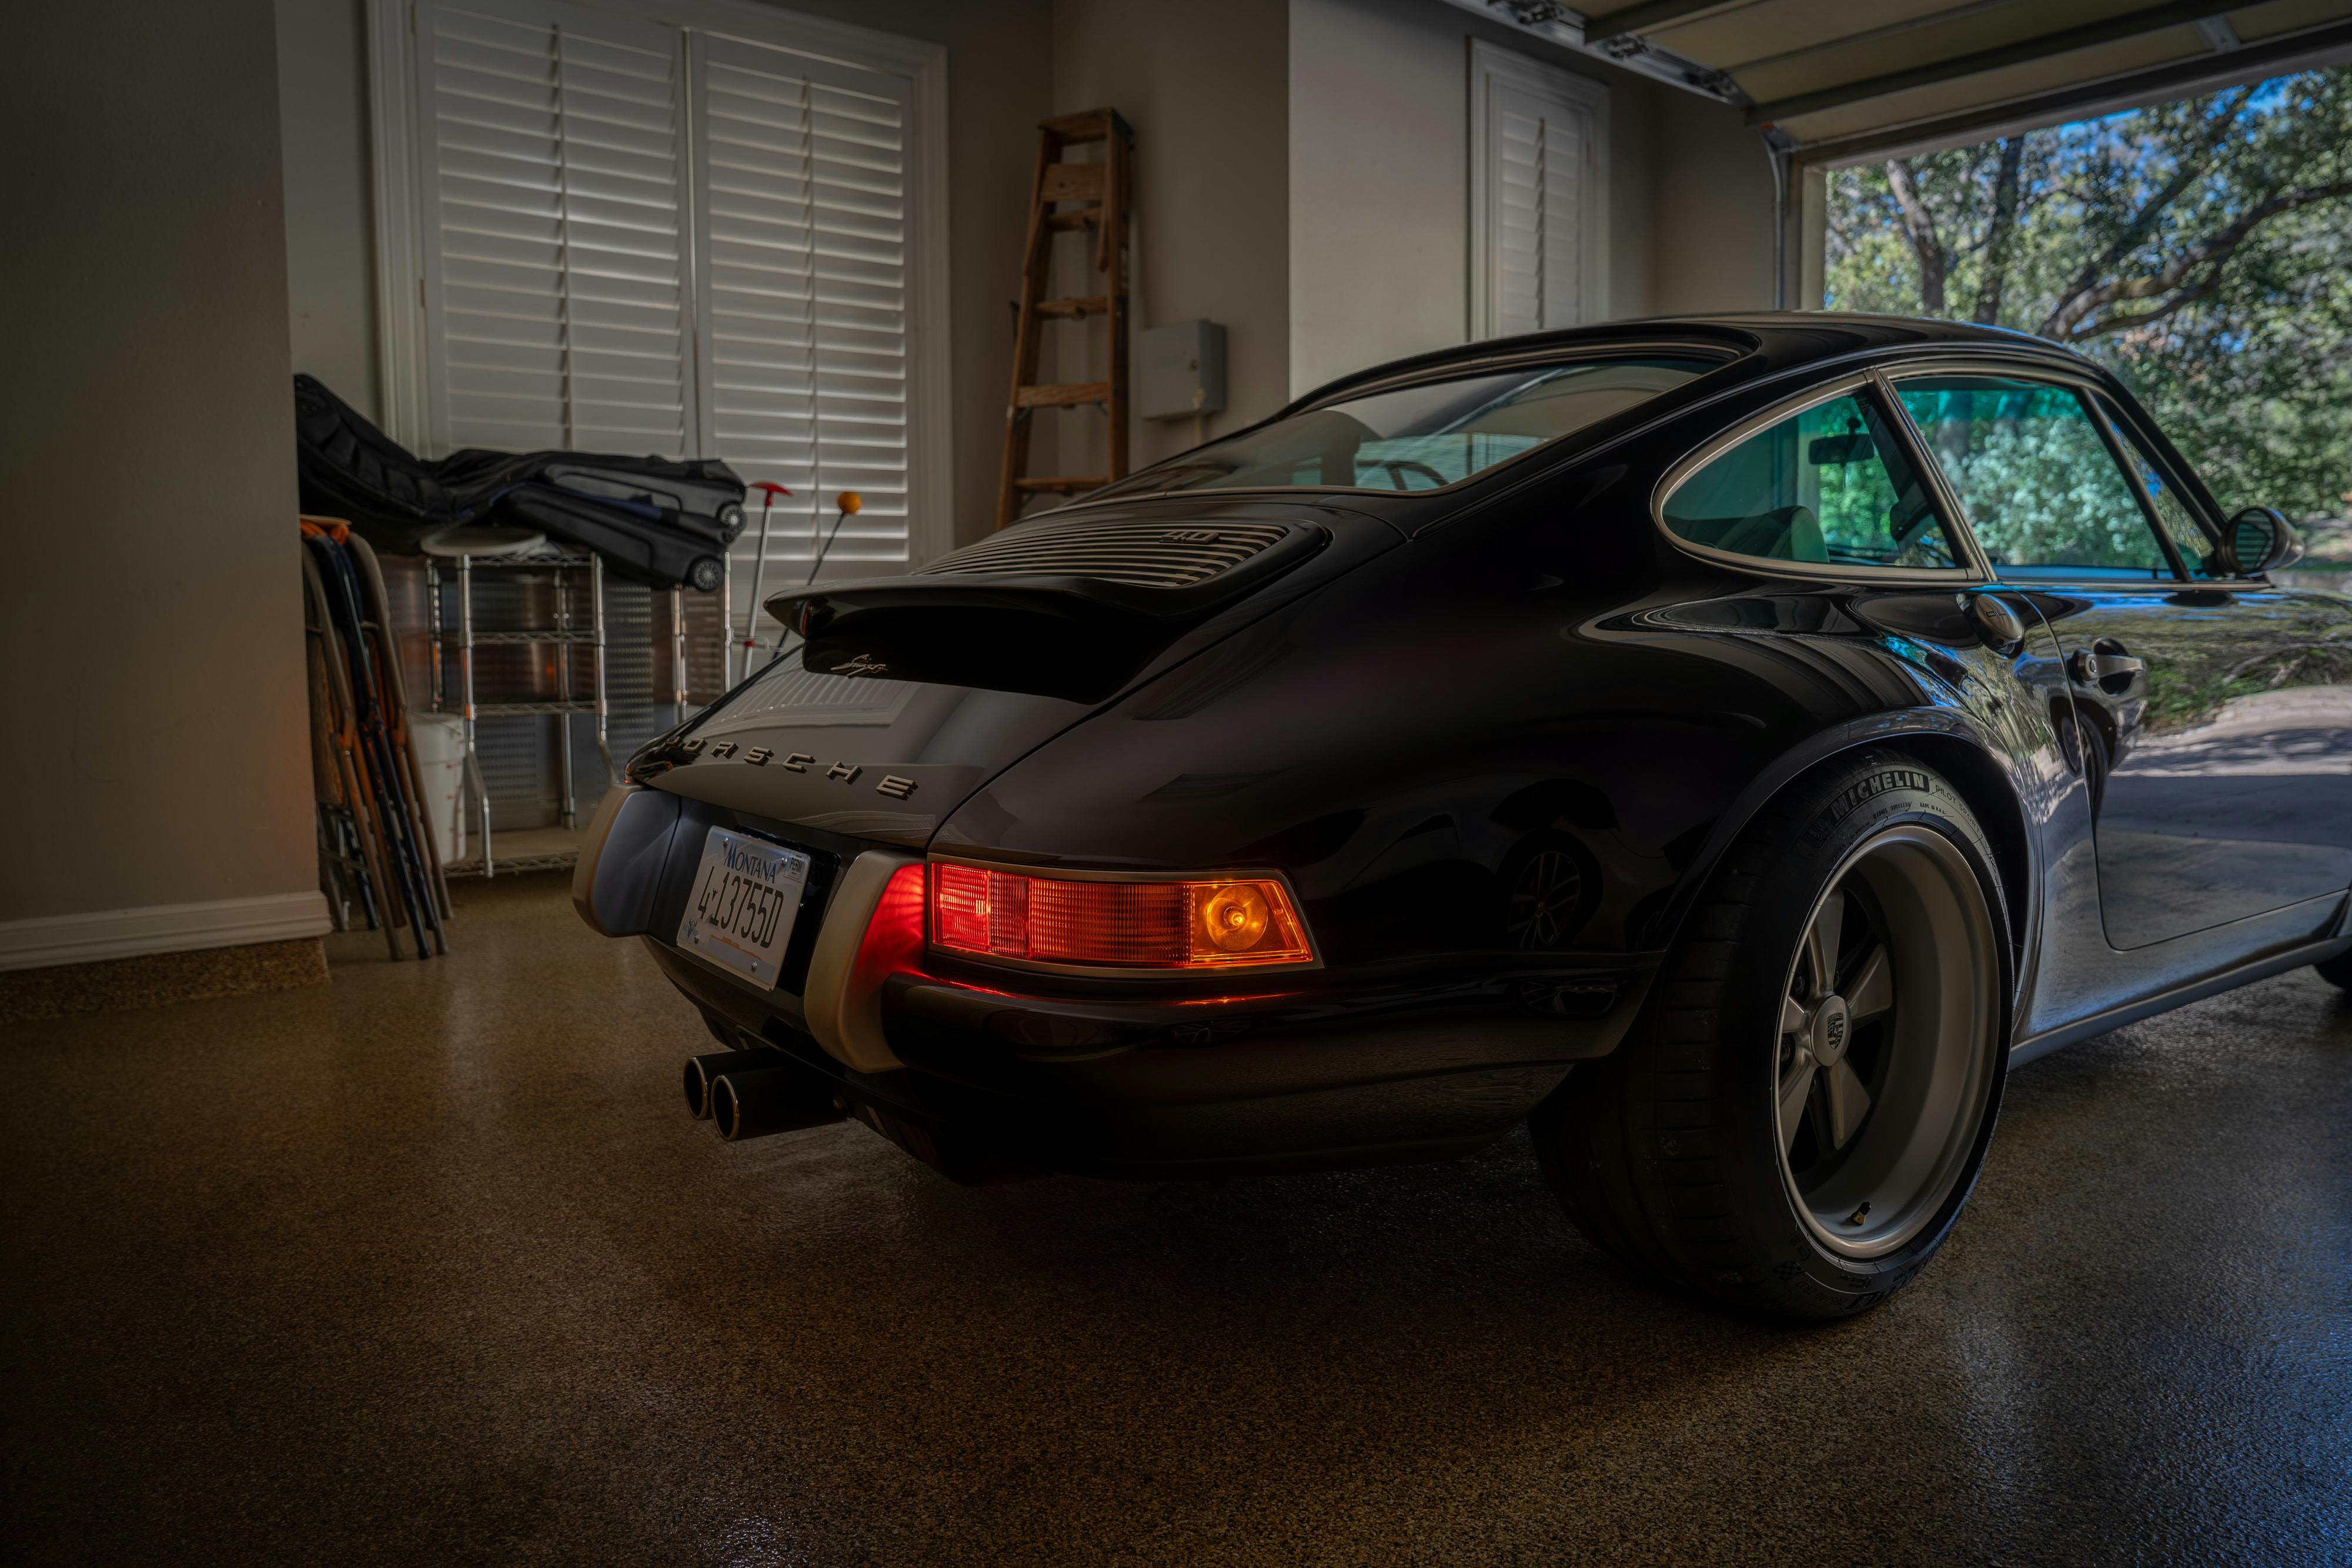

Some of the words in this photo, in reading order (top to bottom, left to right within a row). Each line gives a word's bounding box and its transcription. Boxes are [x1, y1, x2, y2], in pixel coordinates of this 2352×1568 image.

[662, 736, 918, 801] PORSCHE
[1830, 771, 1925, 821] MICHELIN
[1935, 784, 1957, 804] PILOT
[724, 842, 777, 884] MONTANA
